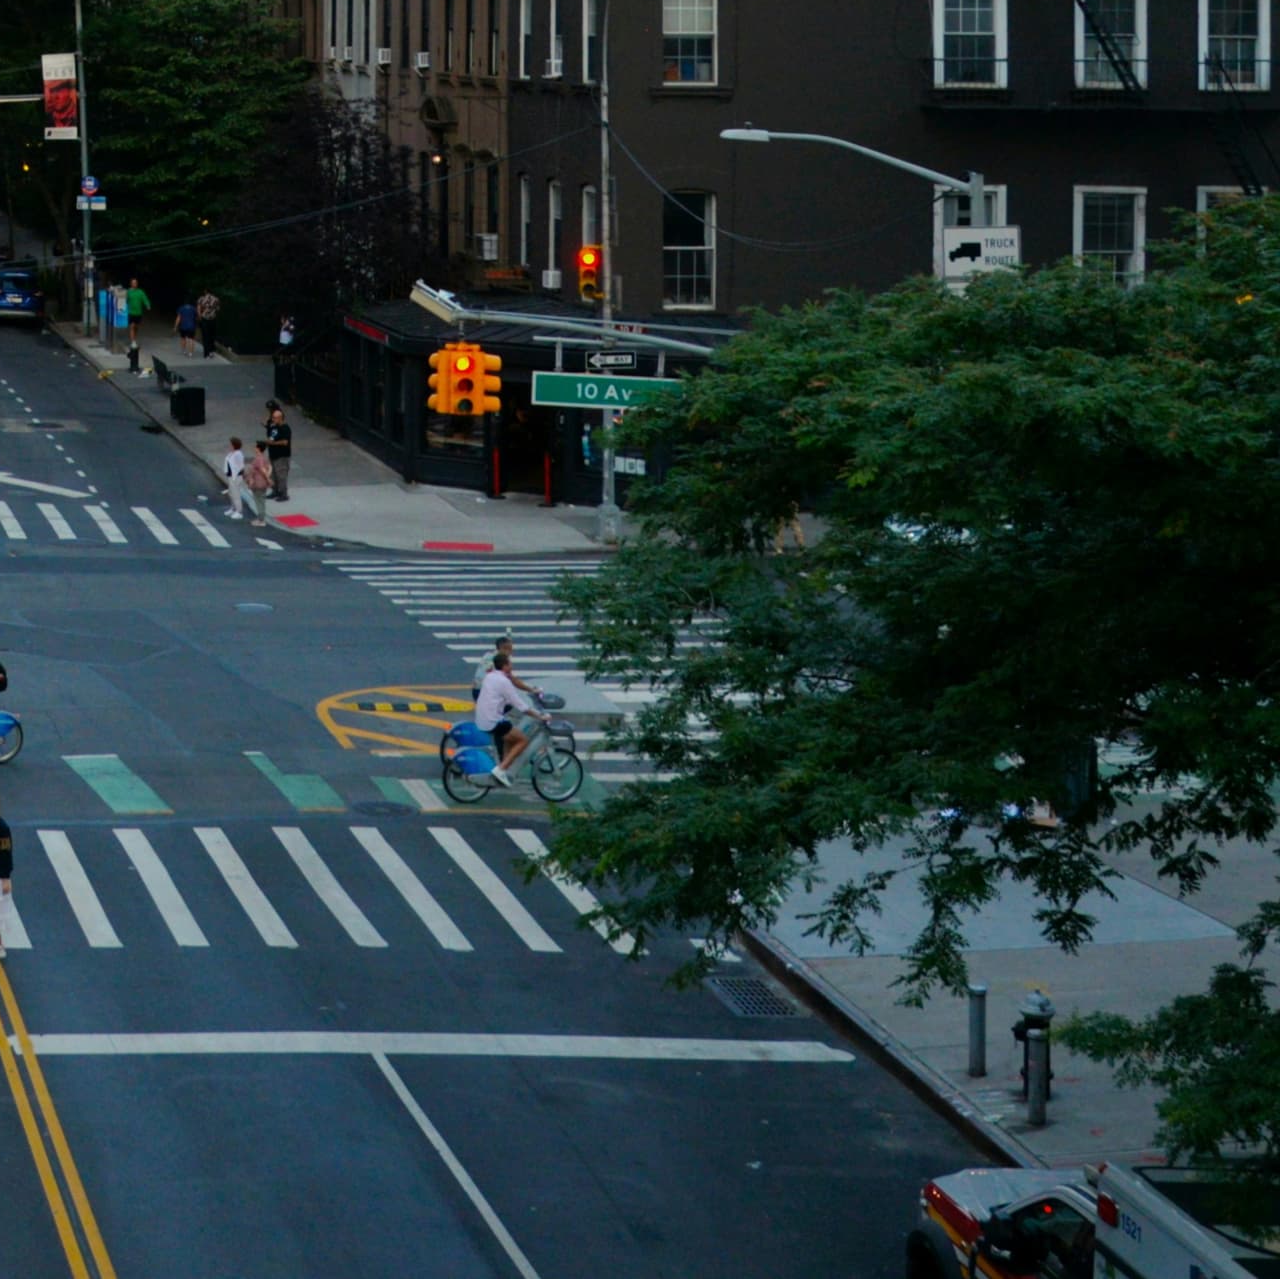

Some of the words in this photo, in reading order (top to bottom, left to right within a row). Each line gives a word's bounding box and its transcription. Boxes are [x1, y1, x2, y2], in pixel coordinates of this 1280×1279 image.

[984, 238, 1016, 249] TRUCK
[576, 382, 598, 399] 10
[603, 384, 633, 401] Av
[1121, 1213, 1142, 1243] 1521
